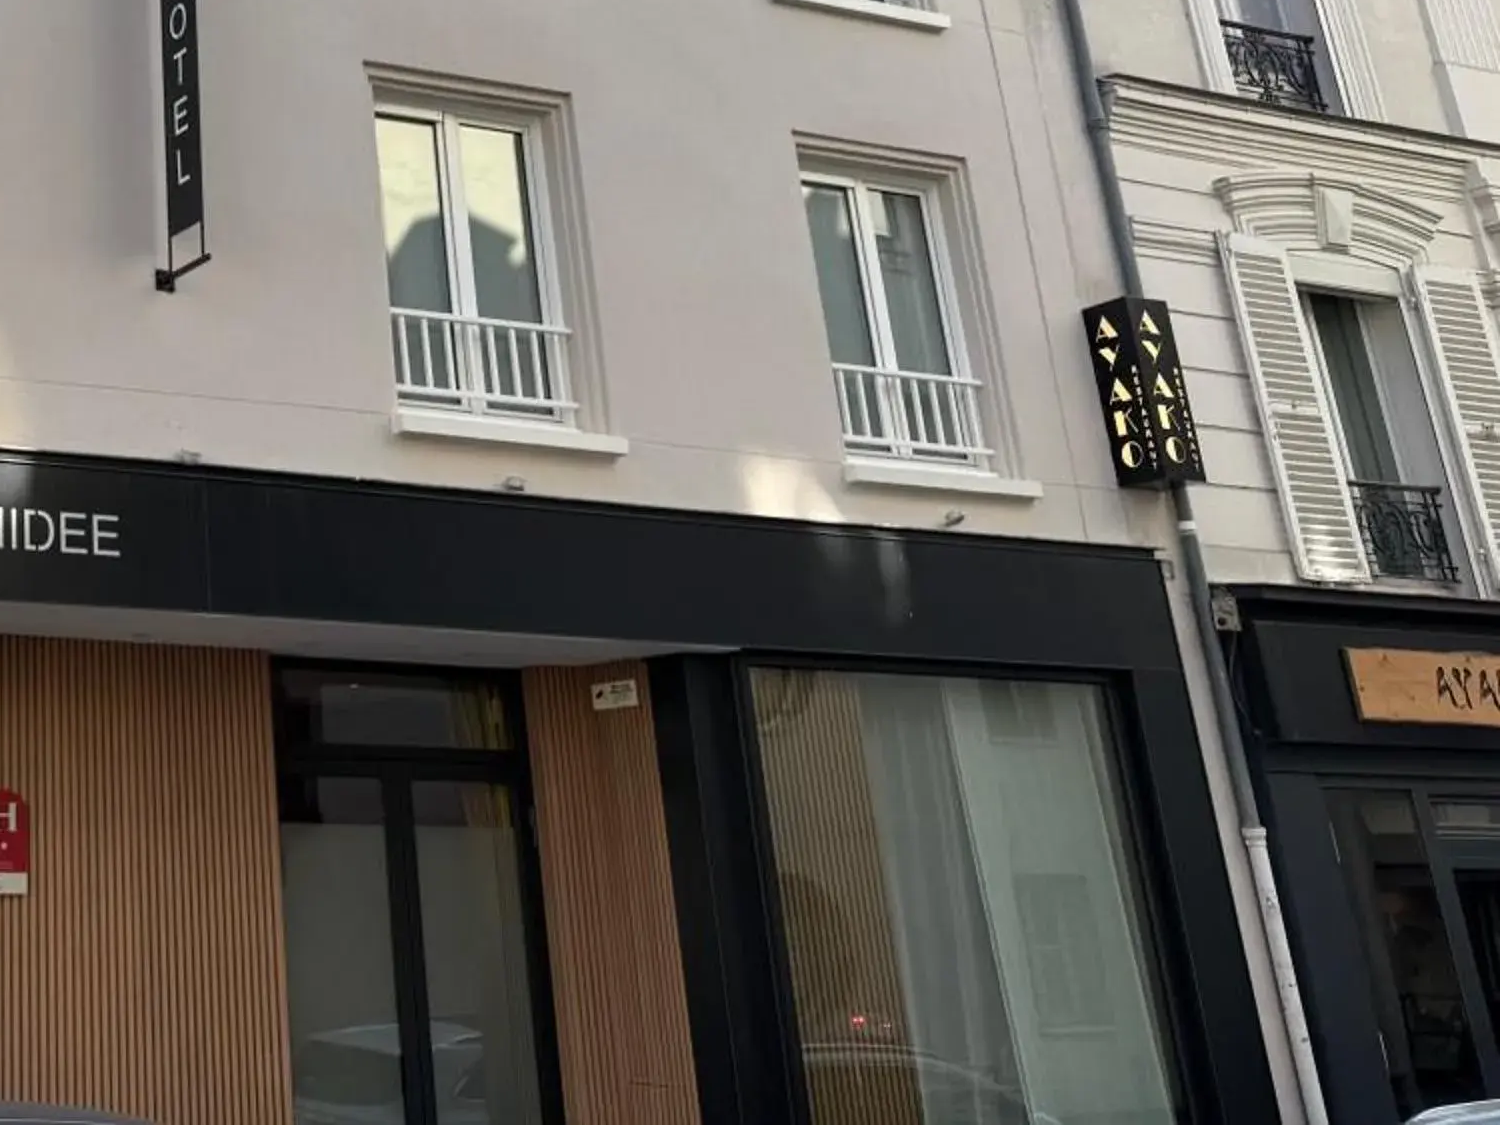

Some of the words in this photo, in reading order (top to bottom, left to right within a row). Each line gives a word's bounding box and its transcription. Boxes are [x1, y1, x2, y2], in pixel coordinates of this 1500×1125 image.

[1095, 314, 1145, 469] AYAKO
[1138, 309, 1188, 464] AYAKO
[1435, 665, 1500, 712] AYA
